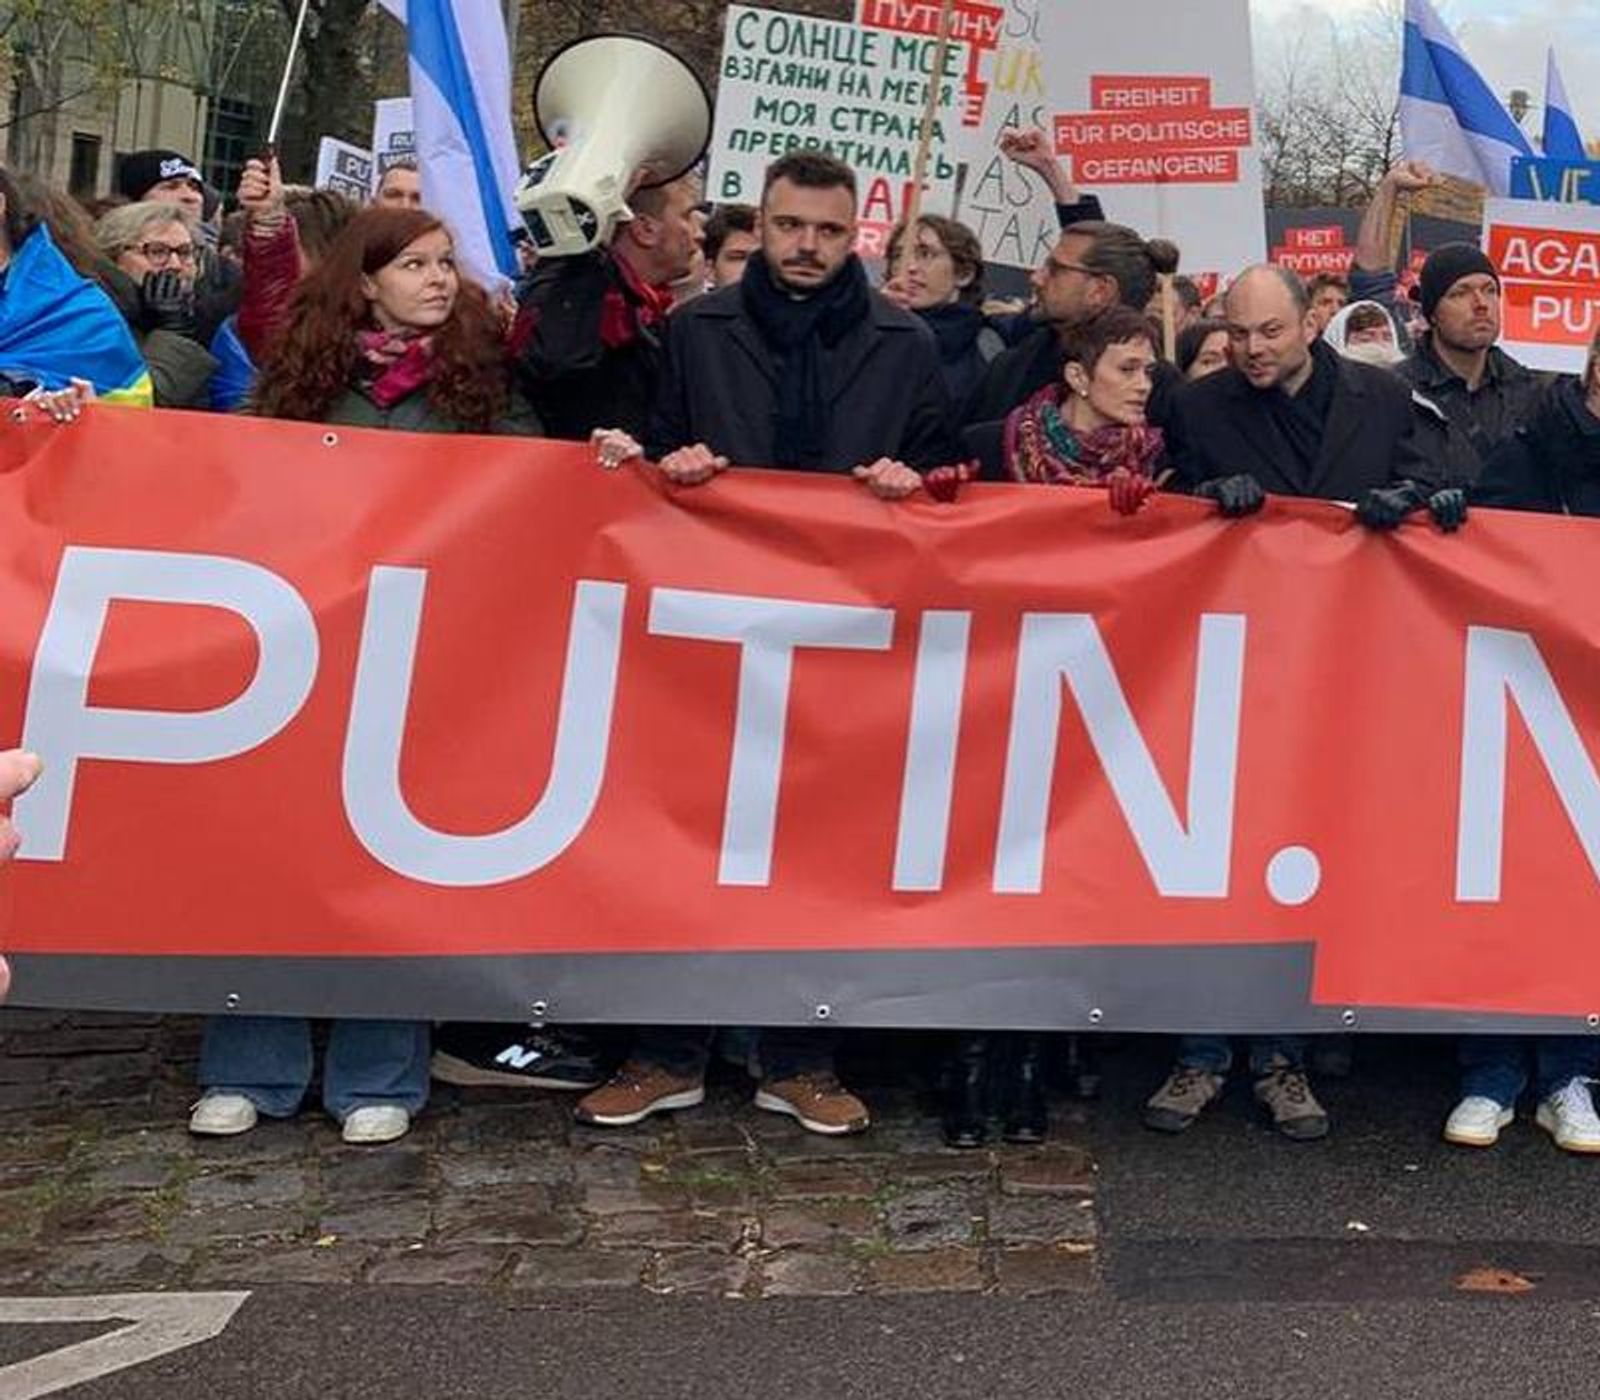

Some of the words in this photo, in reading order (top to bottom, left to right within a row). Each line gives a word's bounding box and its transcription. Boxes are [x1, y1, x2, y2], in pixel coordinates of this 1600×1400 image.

[736, 11, 877, 67] СОЛНЦЕ
[724, 56, 830, 92] ВЗГЛЯНИ
[837, 67, 872, 98] НА
[1101, 86, 1201, 107] FREIHEIT
[753, 96, 817, 127] МОЯ
[831, 106, 946, 143] СТРАНА
[1110, 119, 1248, 142] POLITISCHE
[728, 129, 954, 180] ПРЕВРАТИЛАЬ
[1081, 154, 1230, 180] GEFANGENE
[721, 170, 742, 198] В
[10, 545, 1322, 906] PUTIN.
